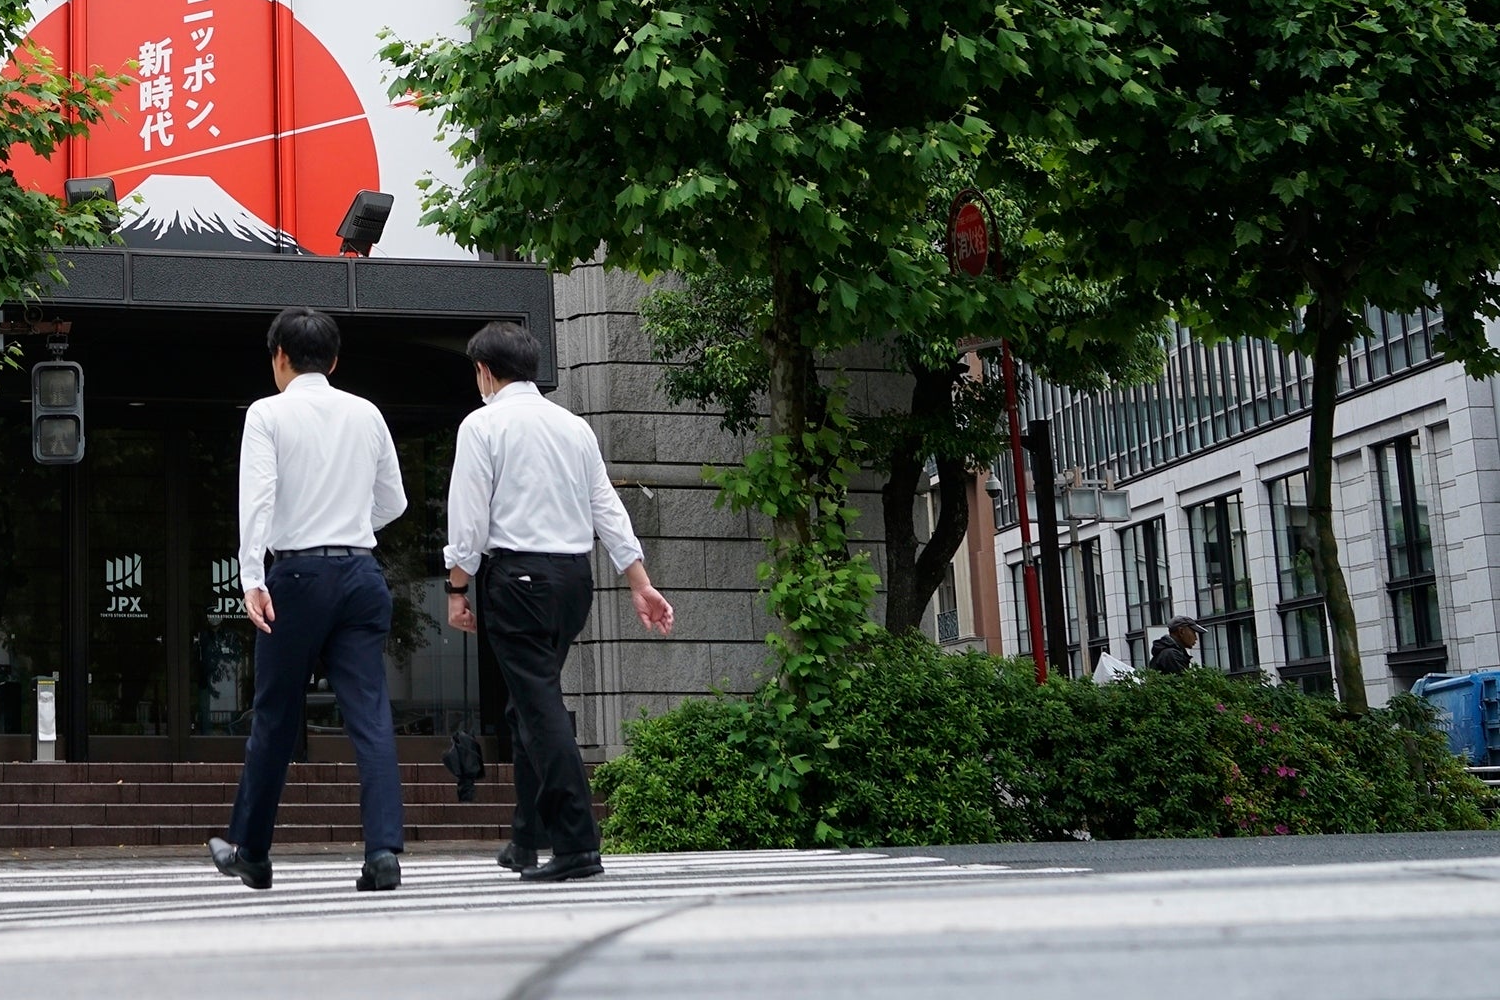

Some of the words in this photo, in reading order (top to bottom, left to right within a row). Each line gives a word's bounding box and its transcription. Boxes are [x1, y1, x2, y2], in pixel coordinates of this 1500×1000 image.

[138, 36, 175, 152] 新時代
[956, 224, 986, 260] 消火栓
[106, 596, 142, 612] JPX
[213, 597, 247, 613] JPX
